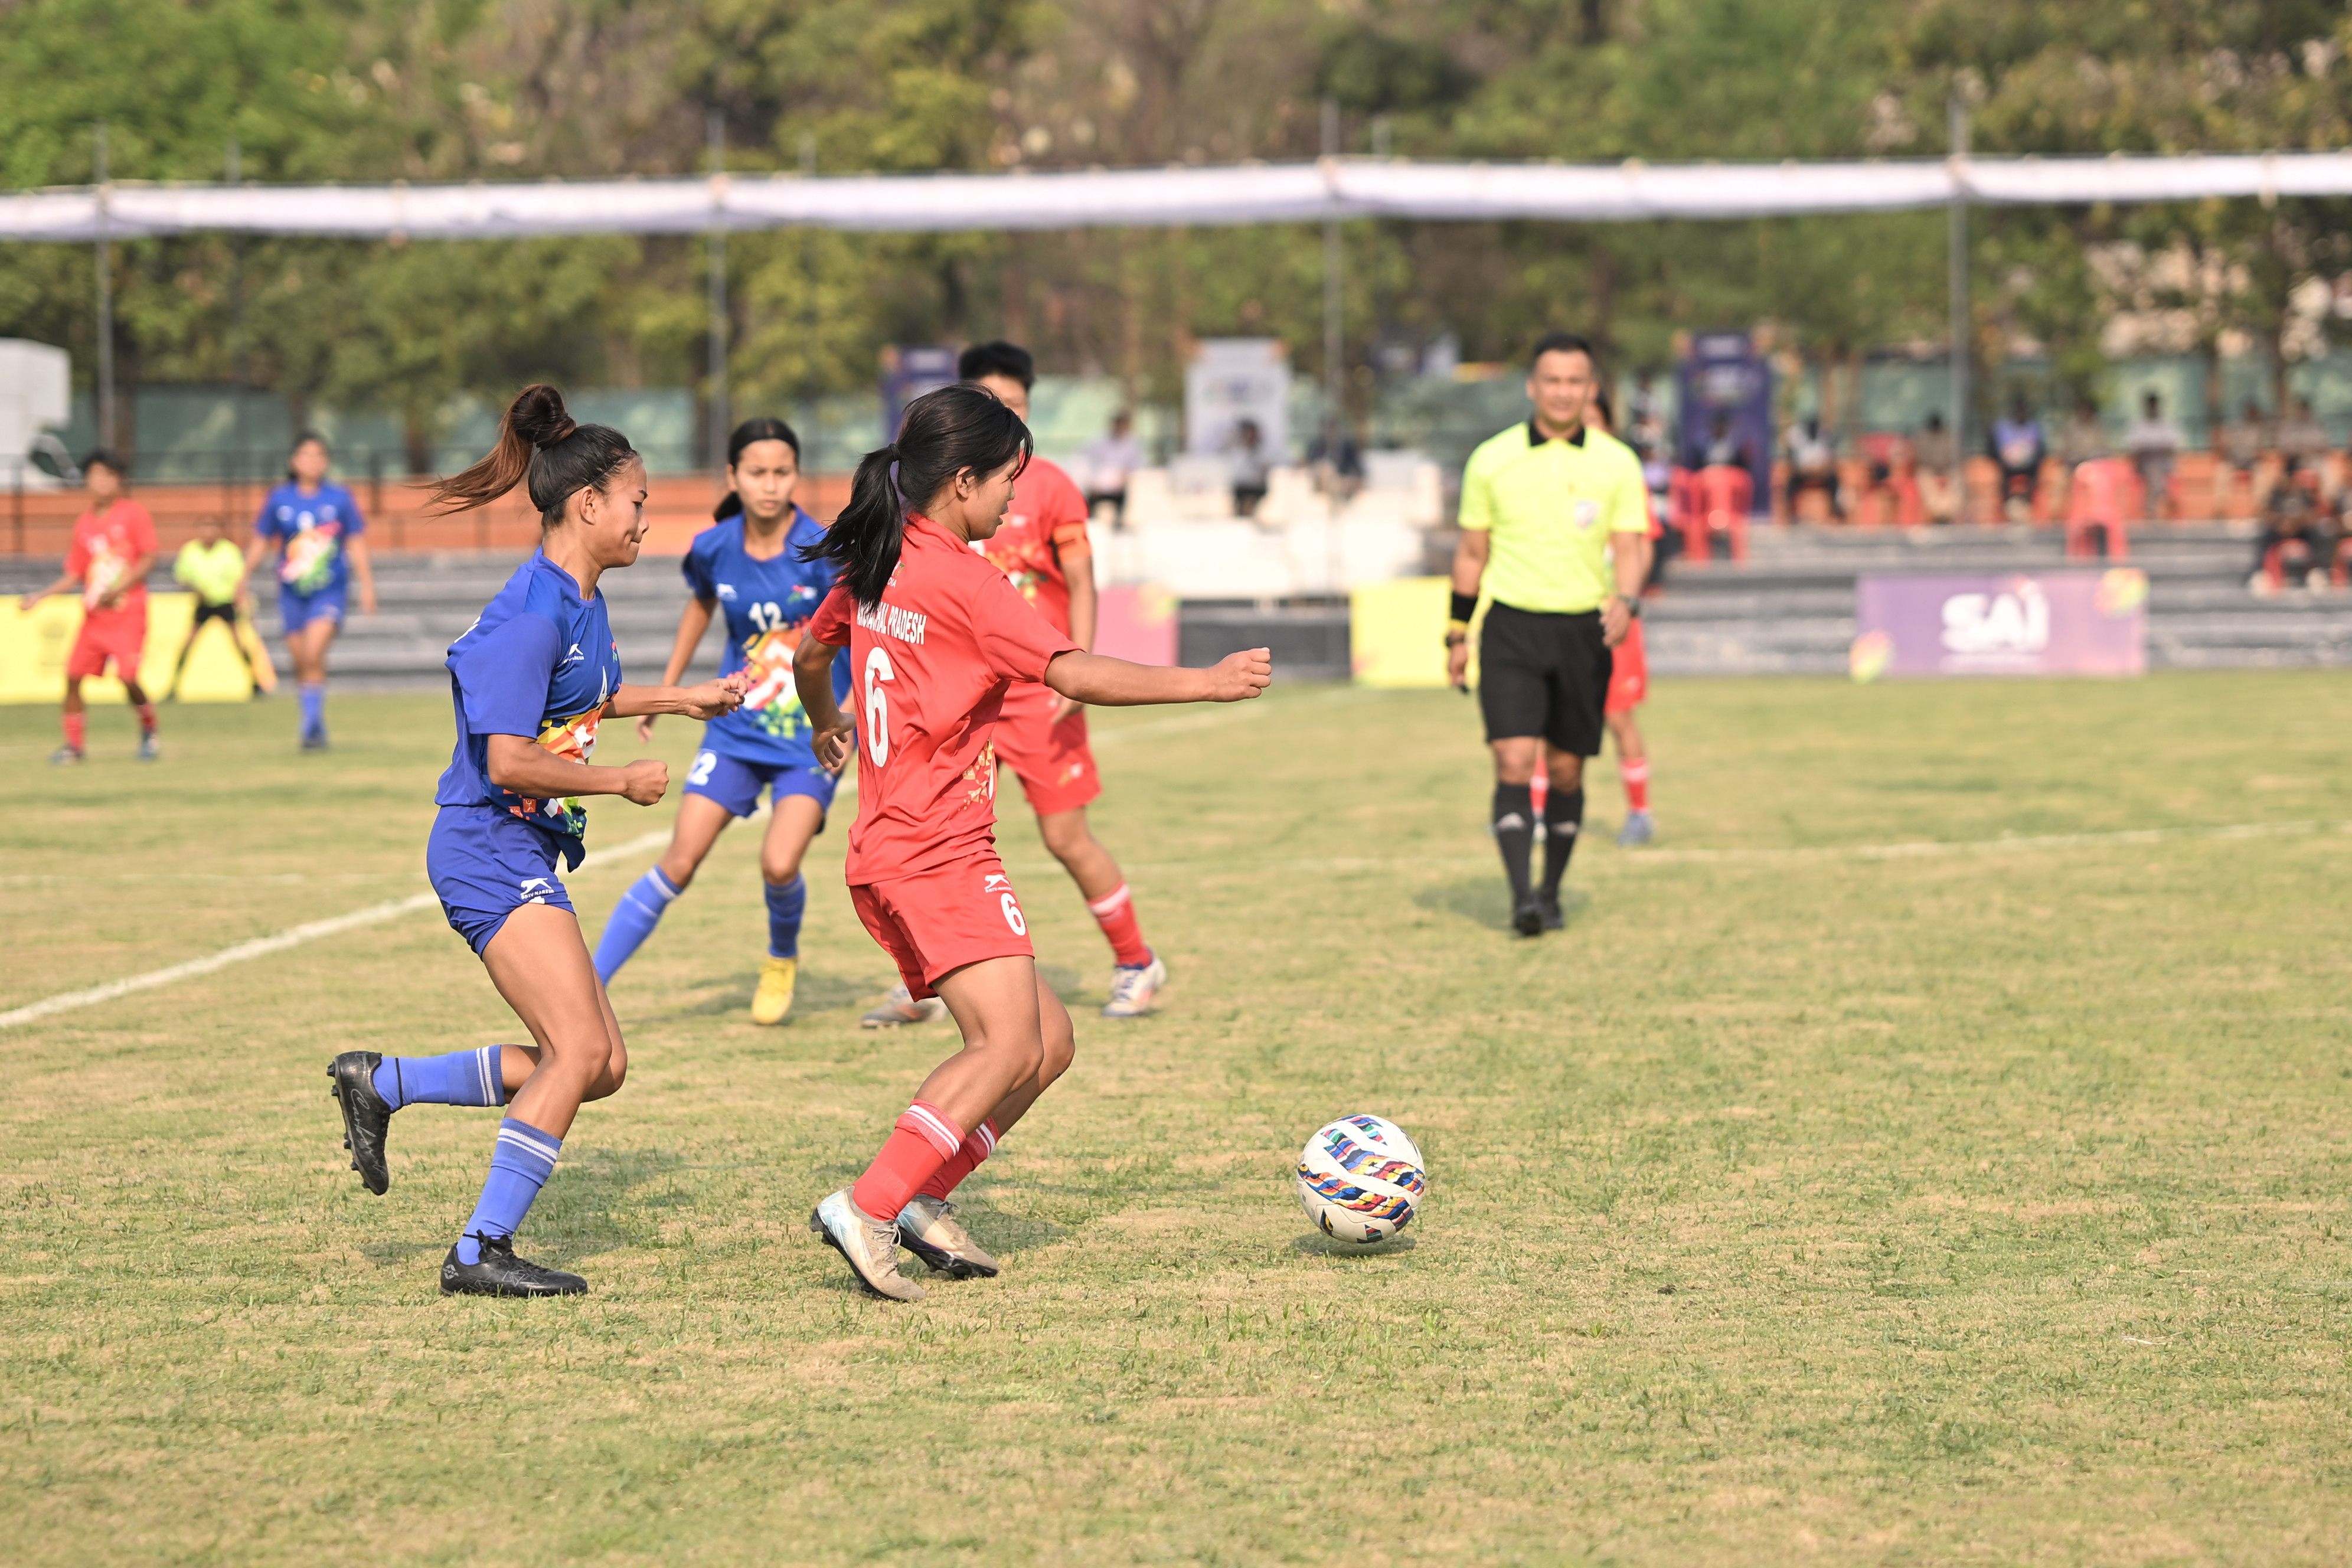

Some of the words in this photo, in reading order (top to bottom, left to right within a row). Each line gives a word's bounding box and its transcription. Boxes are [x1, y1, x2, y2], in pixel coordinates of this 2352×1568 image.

[887, 576, 897, 589] DIA
[748, 601, 790, 633] 12
[887, 605, 927, 645] PRADESH
[864, 646, 895, 768] 6
[1000, 893, 1027, 936] 6
